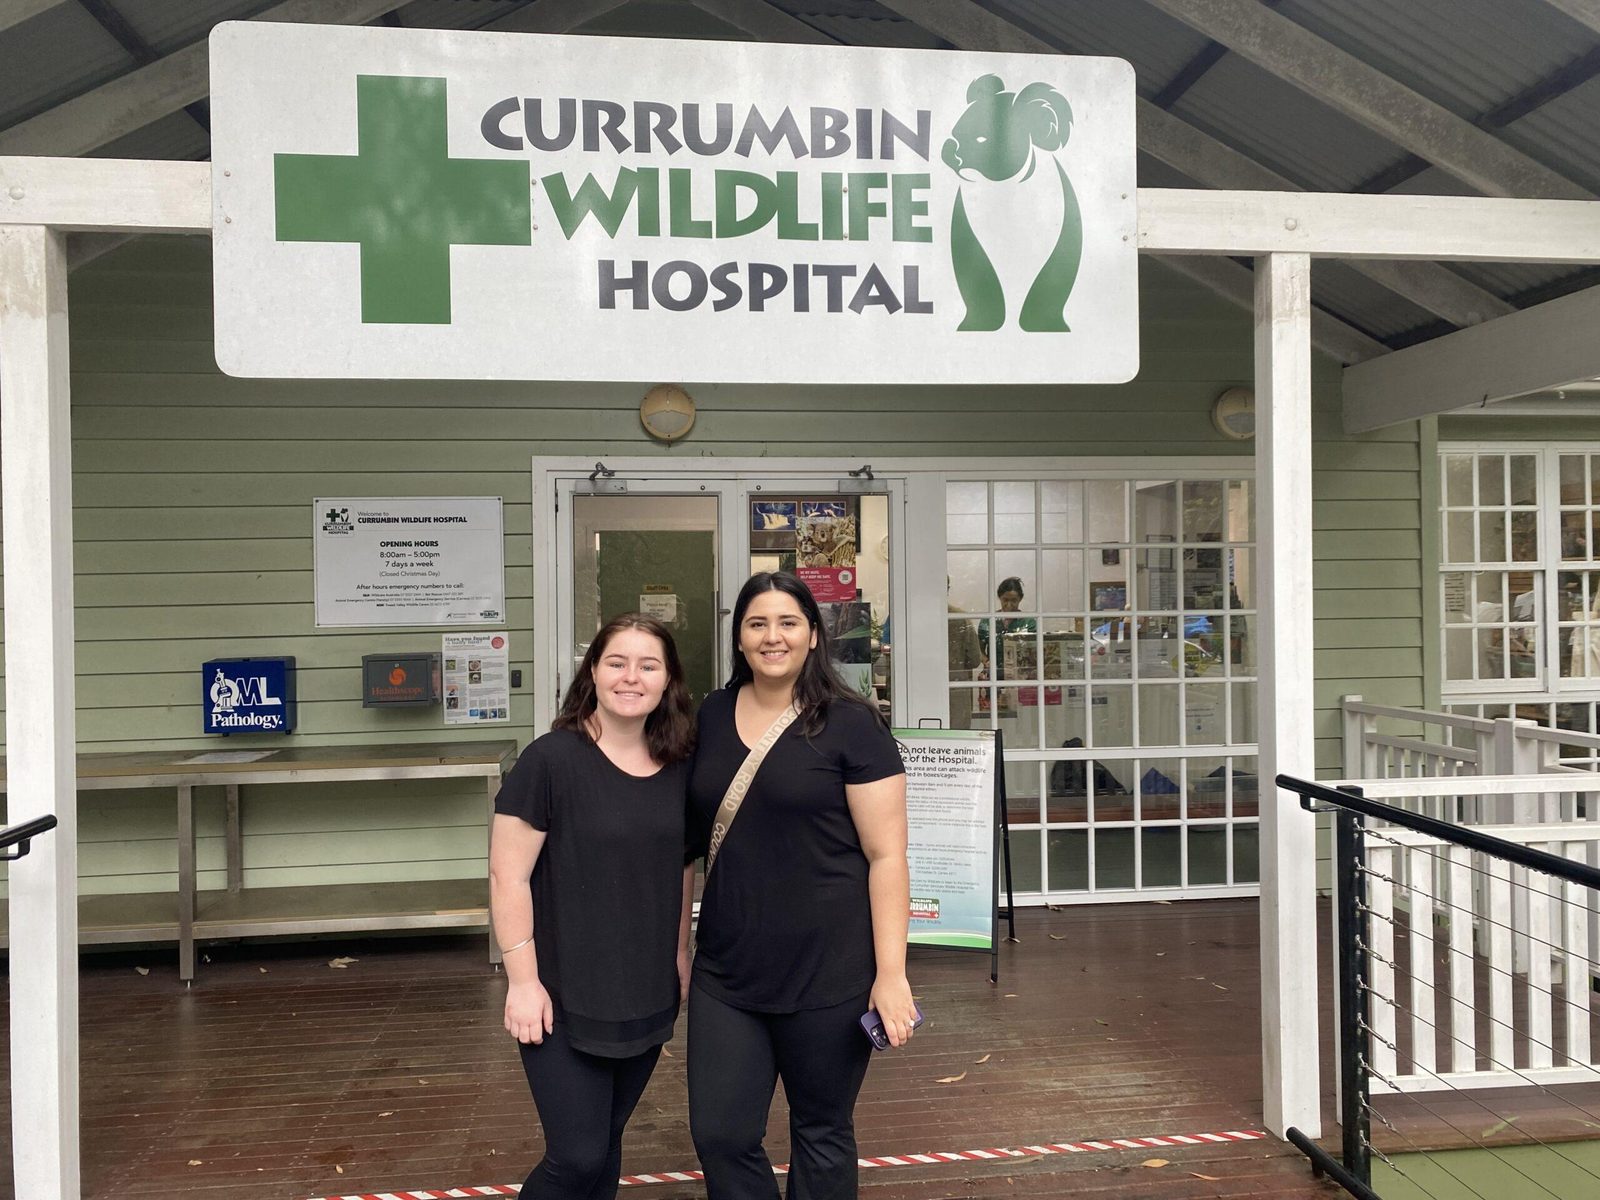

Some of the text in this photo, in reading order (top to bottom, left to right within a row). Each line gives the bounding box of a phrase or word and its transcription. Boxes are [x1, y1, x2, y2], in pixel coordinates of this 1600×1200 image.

[481, 95, 932, 162] CURRUMBIN
[540, 167, 934, 244] WILDLIFE
[598, 259, 934, 316] HOSPITAL
[210, 712, 283, 728] Pathology.
[928, 746, 951, 754] leave
[954, 747, 986, 756] animals
[938, 756, 977, 765] Hospital.
[724, 770, 751, 812] ROAD
